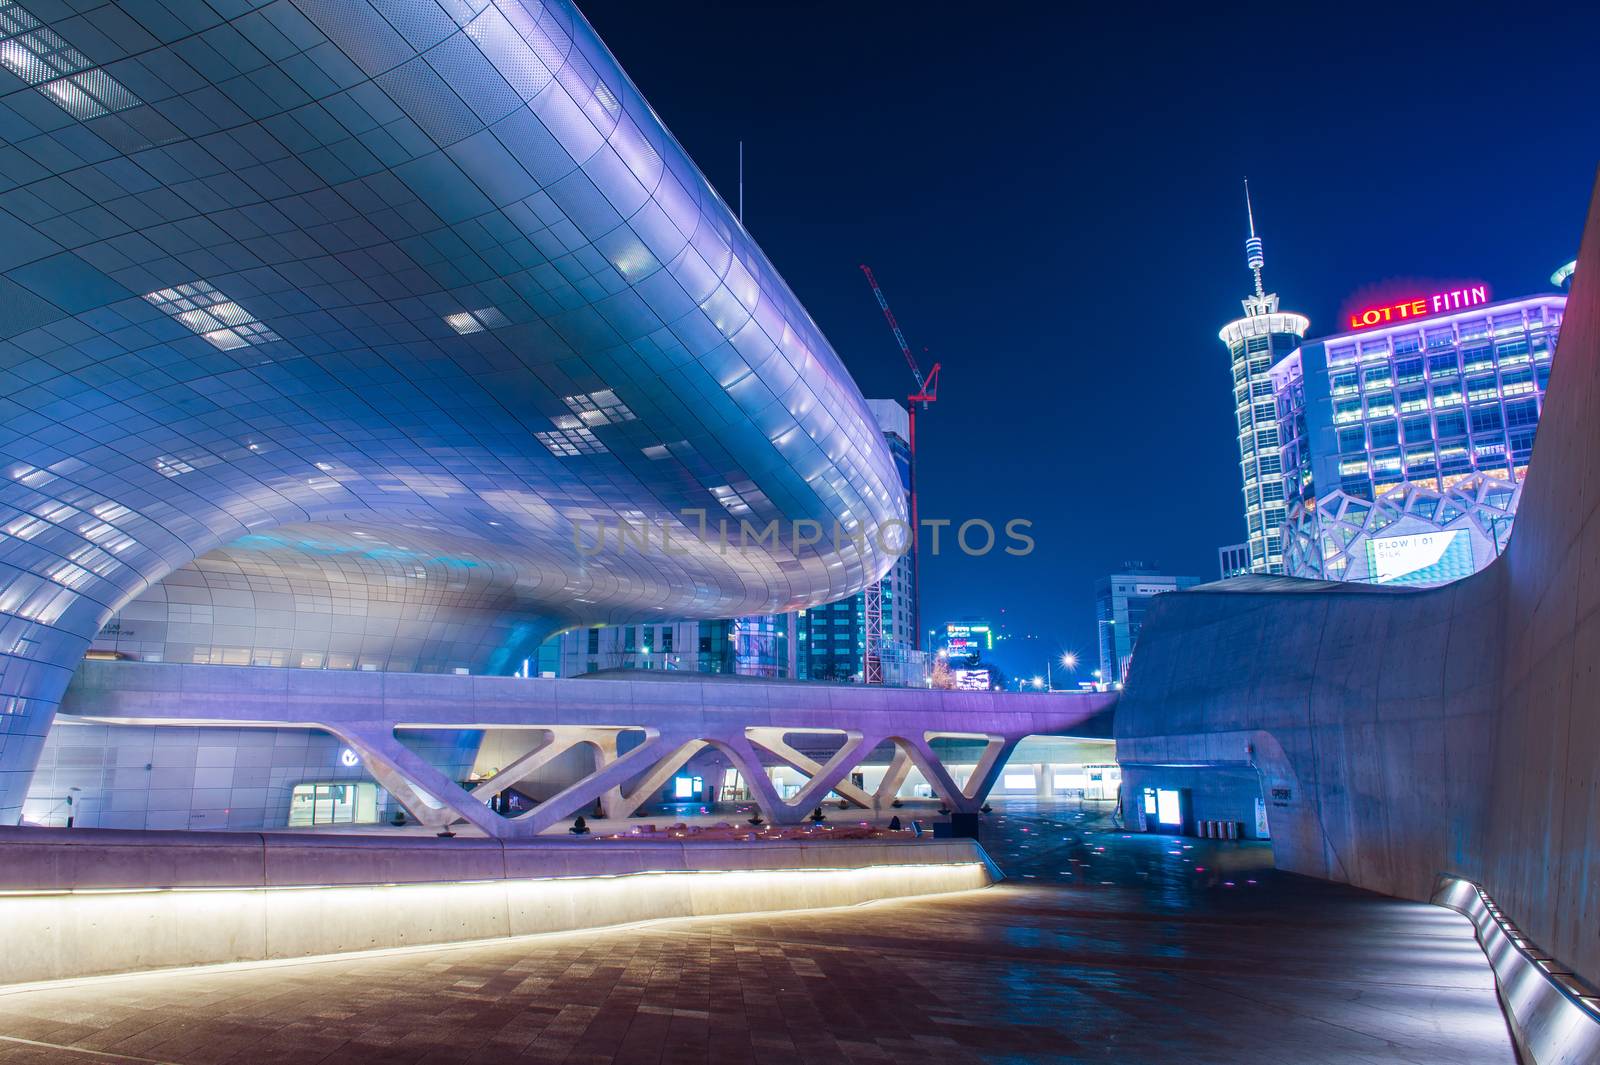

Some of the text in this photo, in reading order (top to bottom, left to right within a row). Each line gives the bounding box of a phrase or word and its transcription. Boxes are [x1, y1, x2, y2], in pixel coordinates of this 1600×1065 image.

[1351, 286, 1486, 327] LOTTE FITIN
[1378, 539, 1409, 549] FLOW
